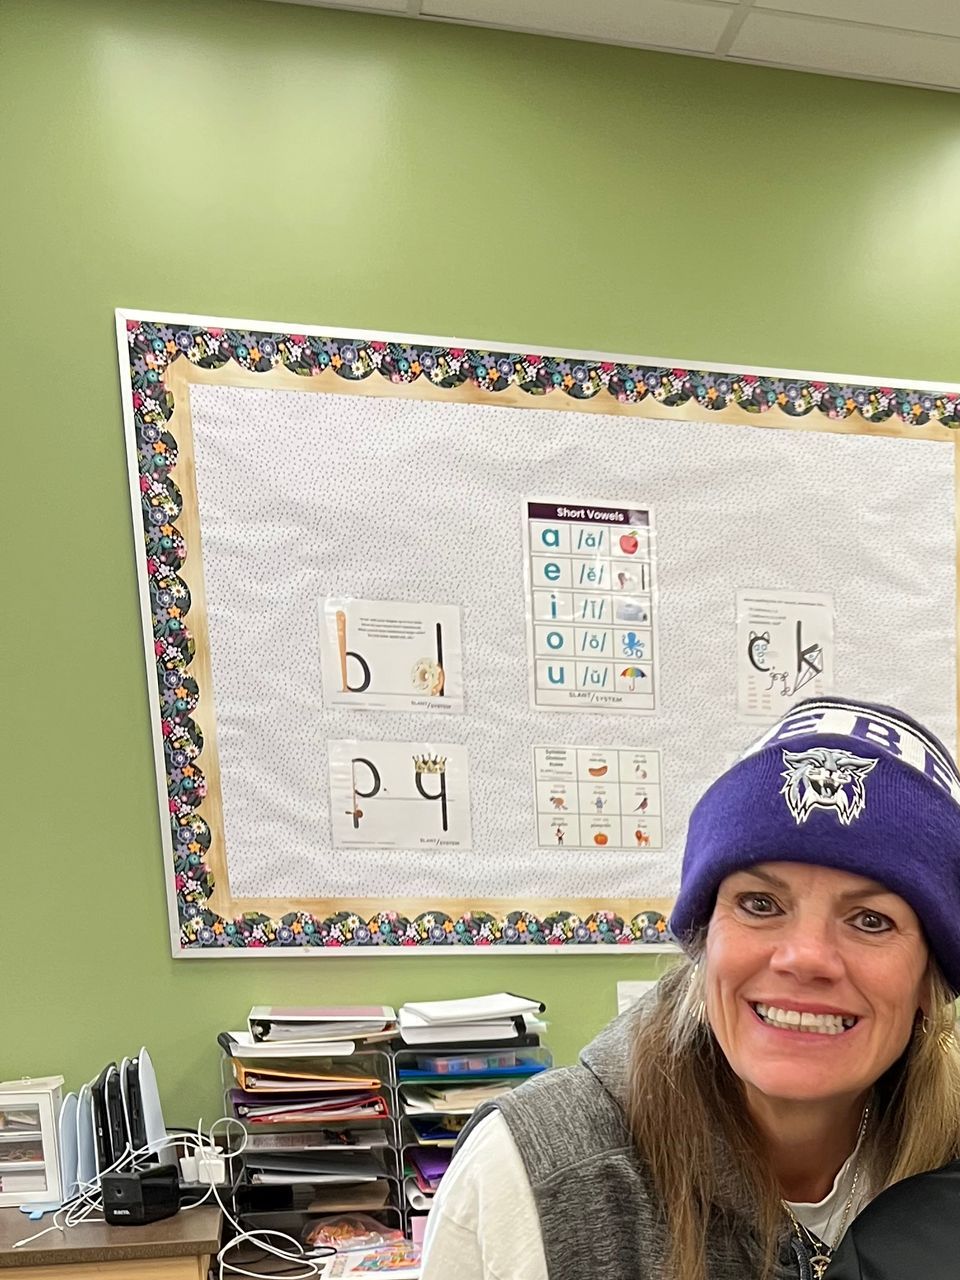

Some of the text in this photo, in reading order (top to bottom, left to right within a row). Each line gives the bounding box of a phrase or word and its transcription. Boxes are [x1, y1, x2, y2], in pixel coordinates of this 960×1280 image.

[556, 507, 624, 522] Short Vowels
[541, 528, 560, 548] a
[543, 562, 561, 581] e
[549, 593, 558, 619] i
[546, 631, 564, 650] o
[547, 665, 565, 685] u
